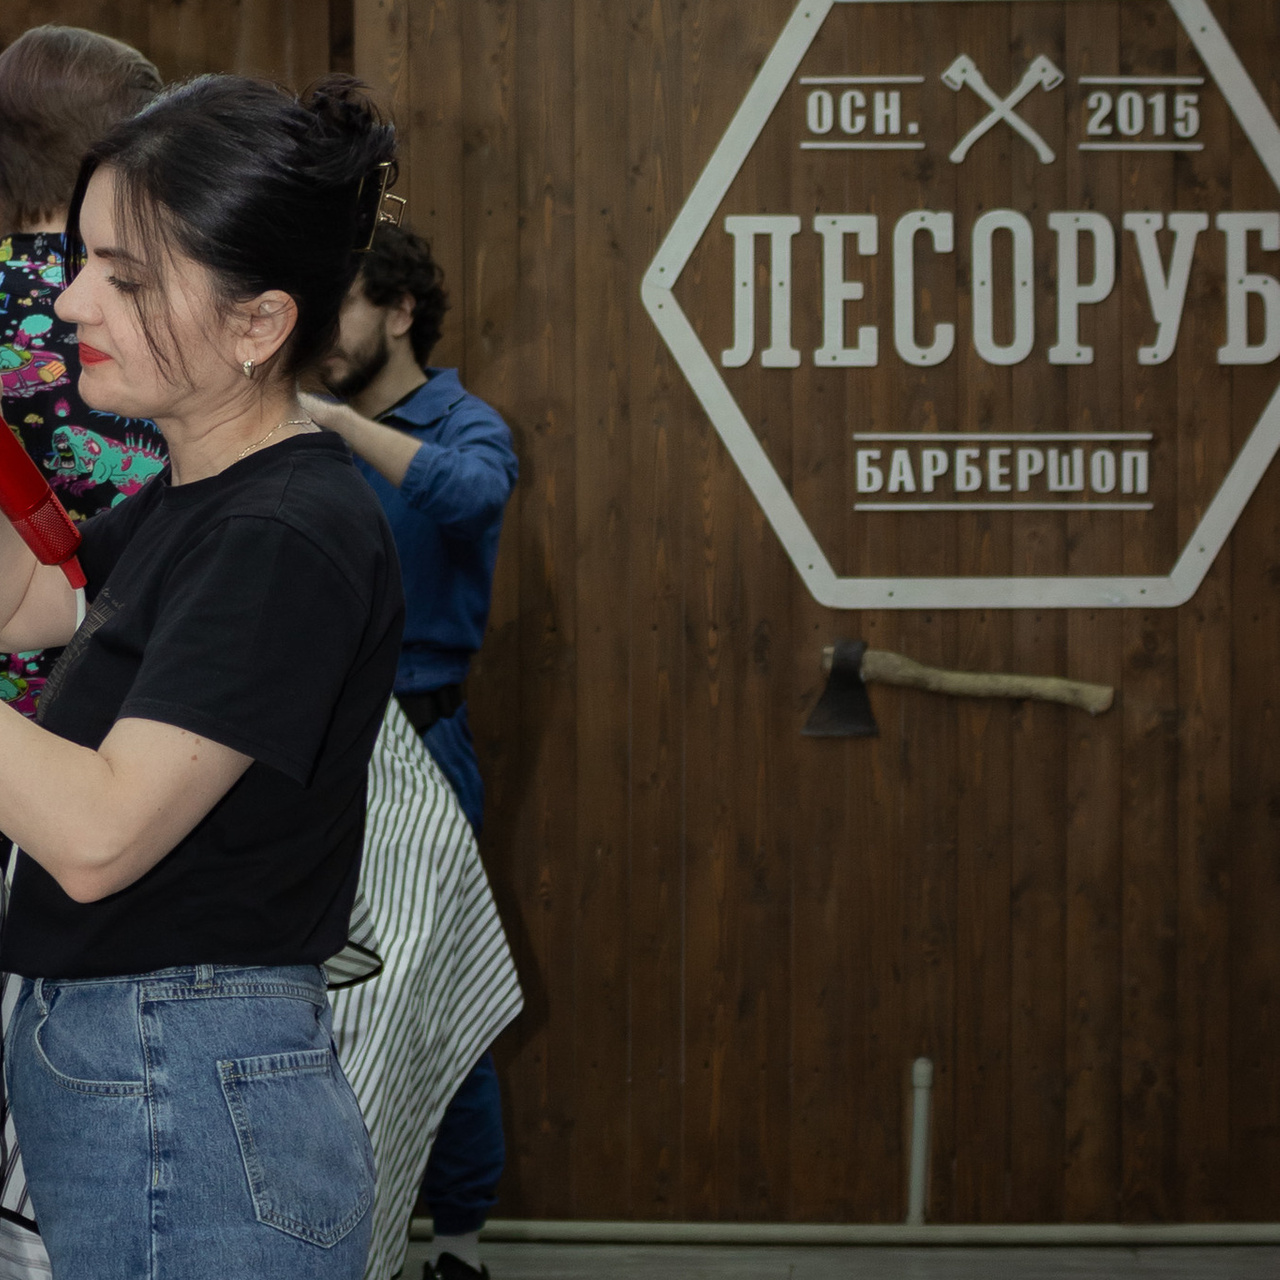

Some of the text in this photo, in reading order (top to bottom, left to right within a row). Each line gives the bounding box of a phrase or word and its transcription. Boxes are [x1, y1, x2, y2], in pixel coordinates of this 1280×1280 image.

[806, 89, 1200, 138] ОСН. 2015
[721, 209, 1280, 368] ЛЕСОРУБ
[856, 447, 1149, 495] БАРБЕРШОП
